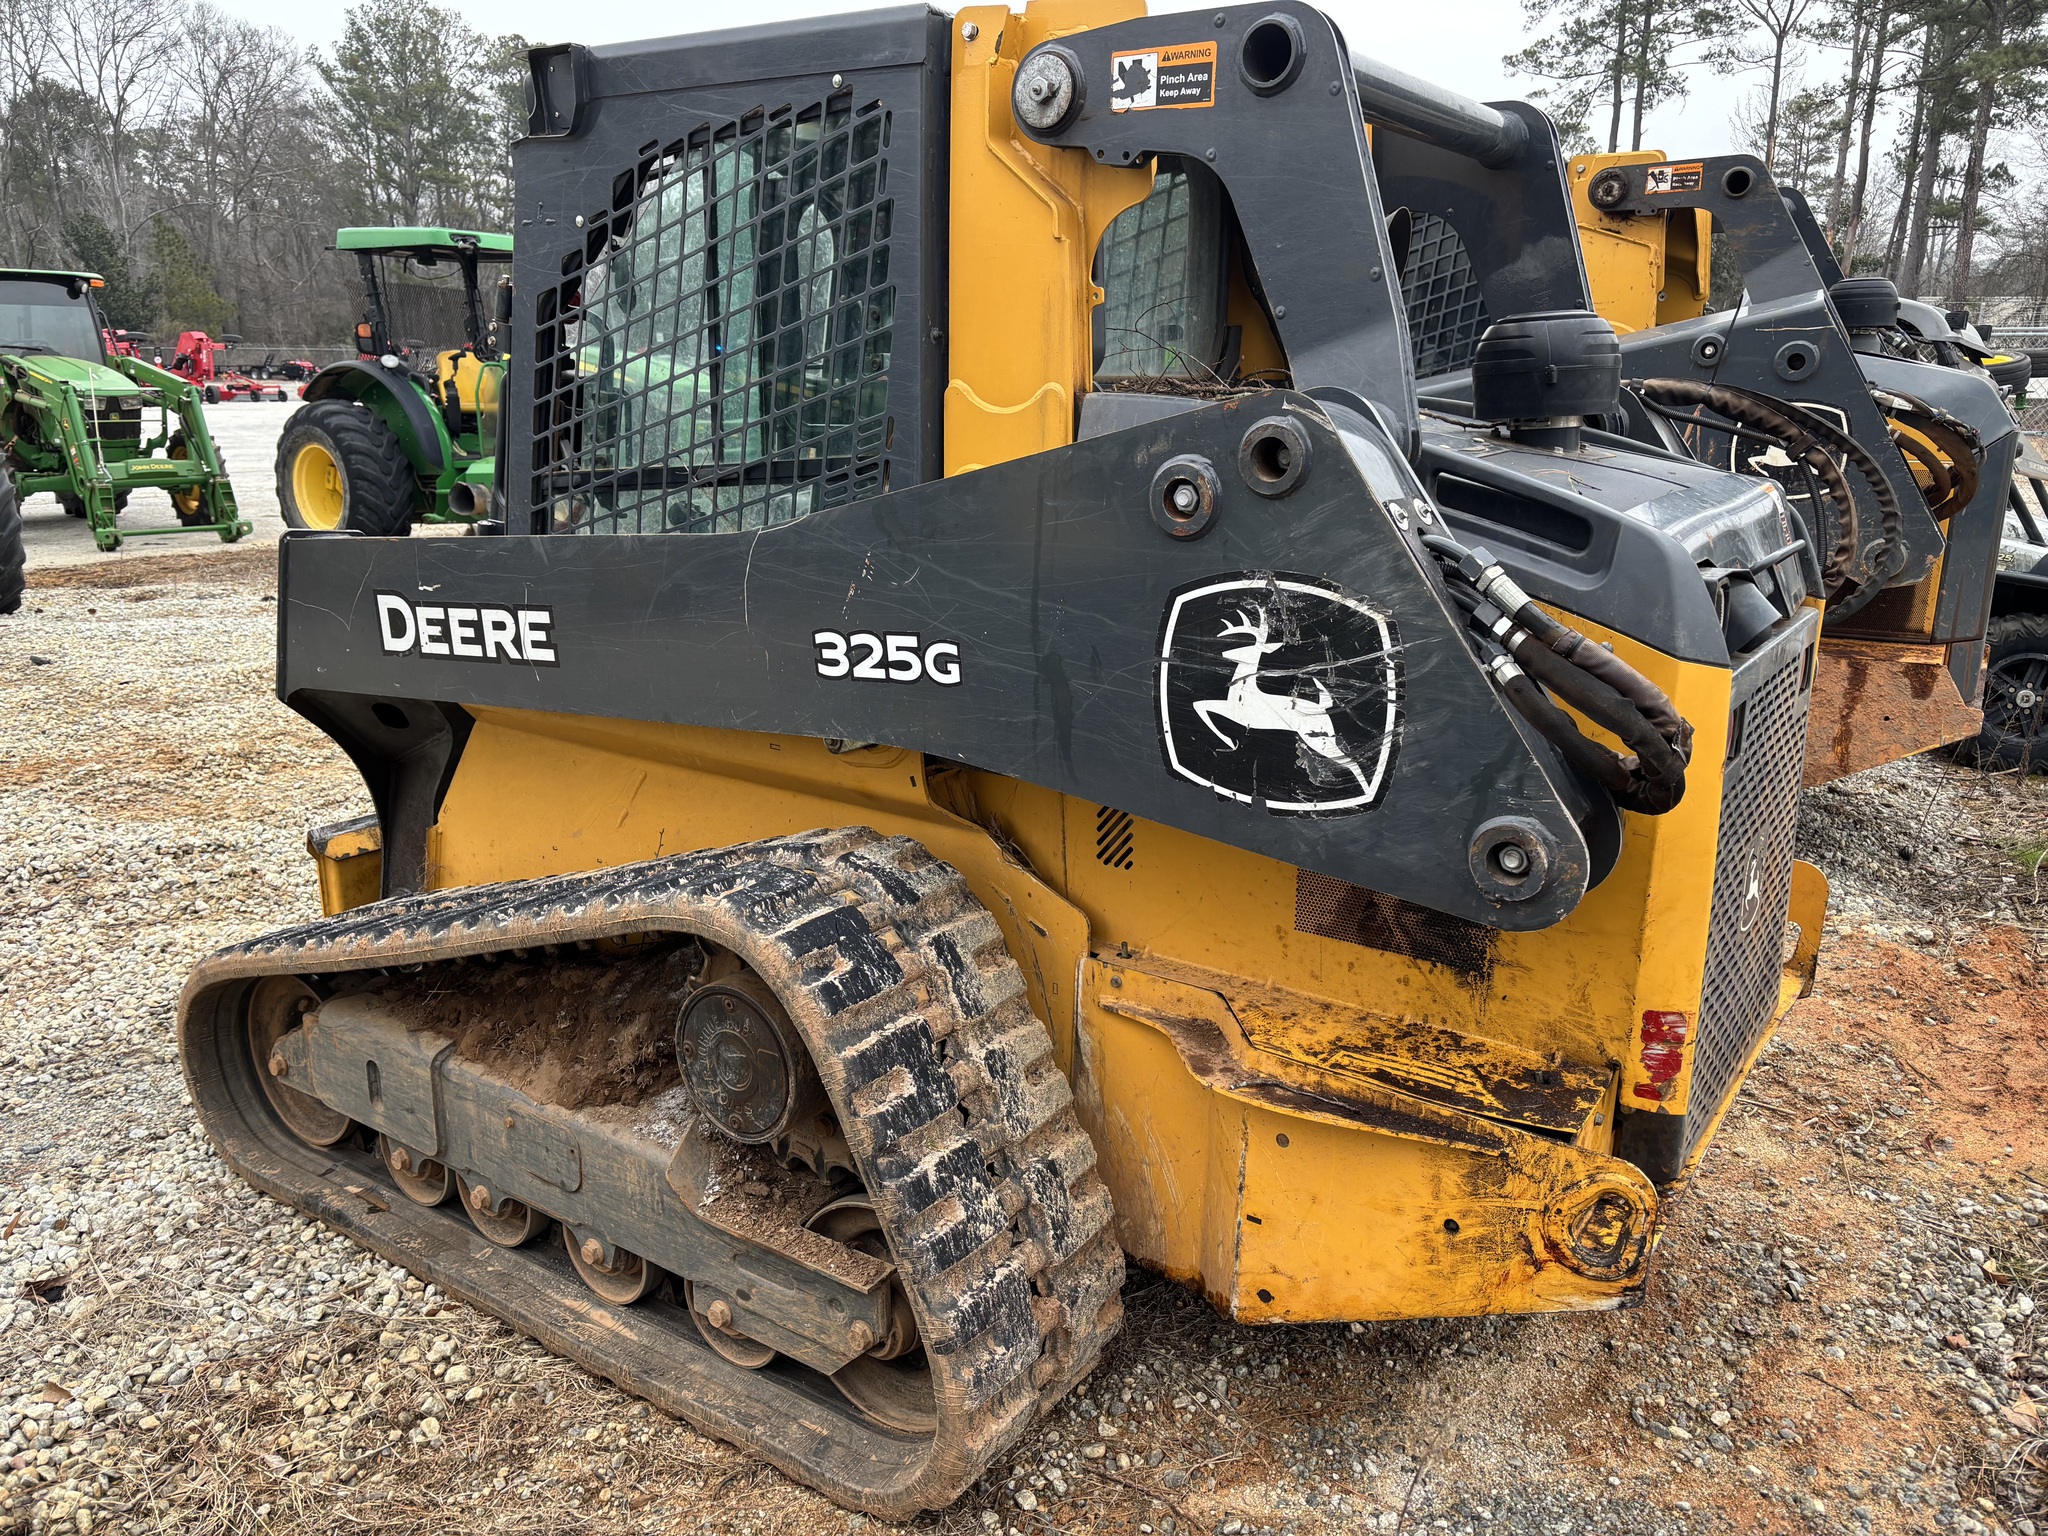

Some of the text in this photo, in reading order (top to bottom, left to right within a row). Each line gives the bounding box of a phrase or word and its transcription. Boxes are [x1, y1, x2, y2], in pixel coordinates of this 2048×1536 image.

[1171, 48, 1212, 60] WARNING
[1160, 72, 1209, 85] Pinch Area
[1160, 86, 1201, 98] Keep Away
[376, 594, 556, 662] DEERE
[814, 631, 961, 685] 325G
